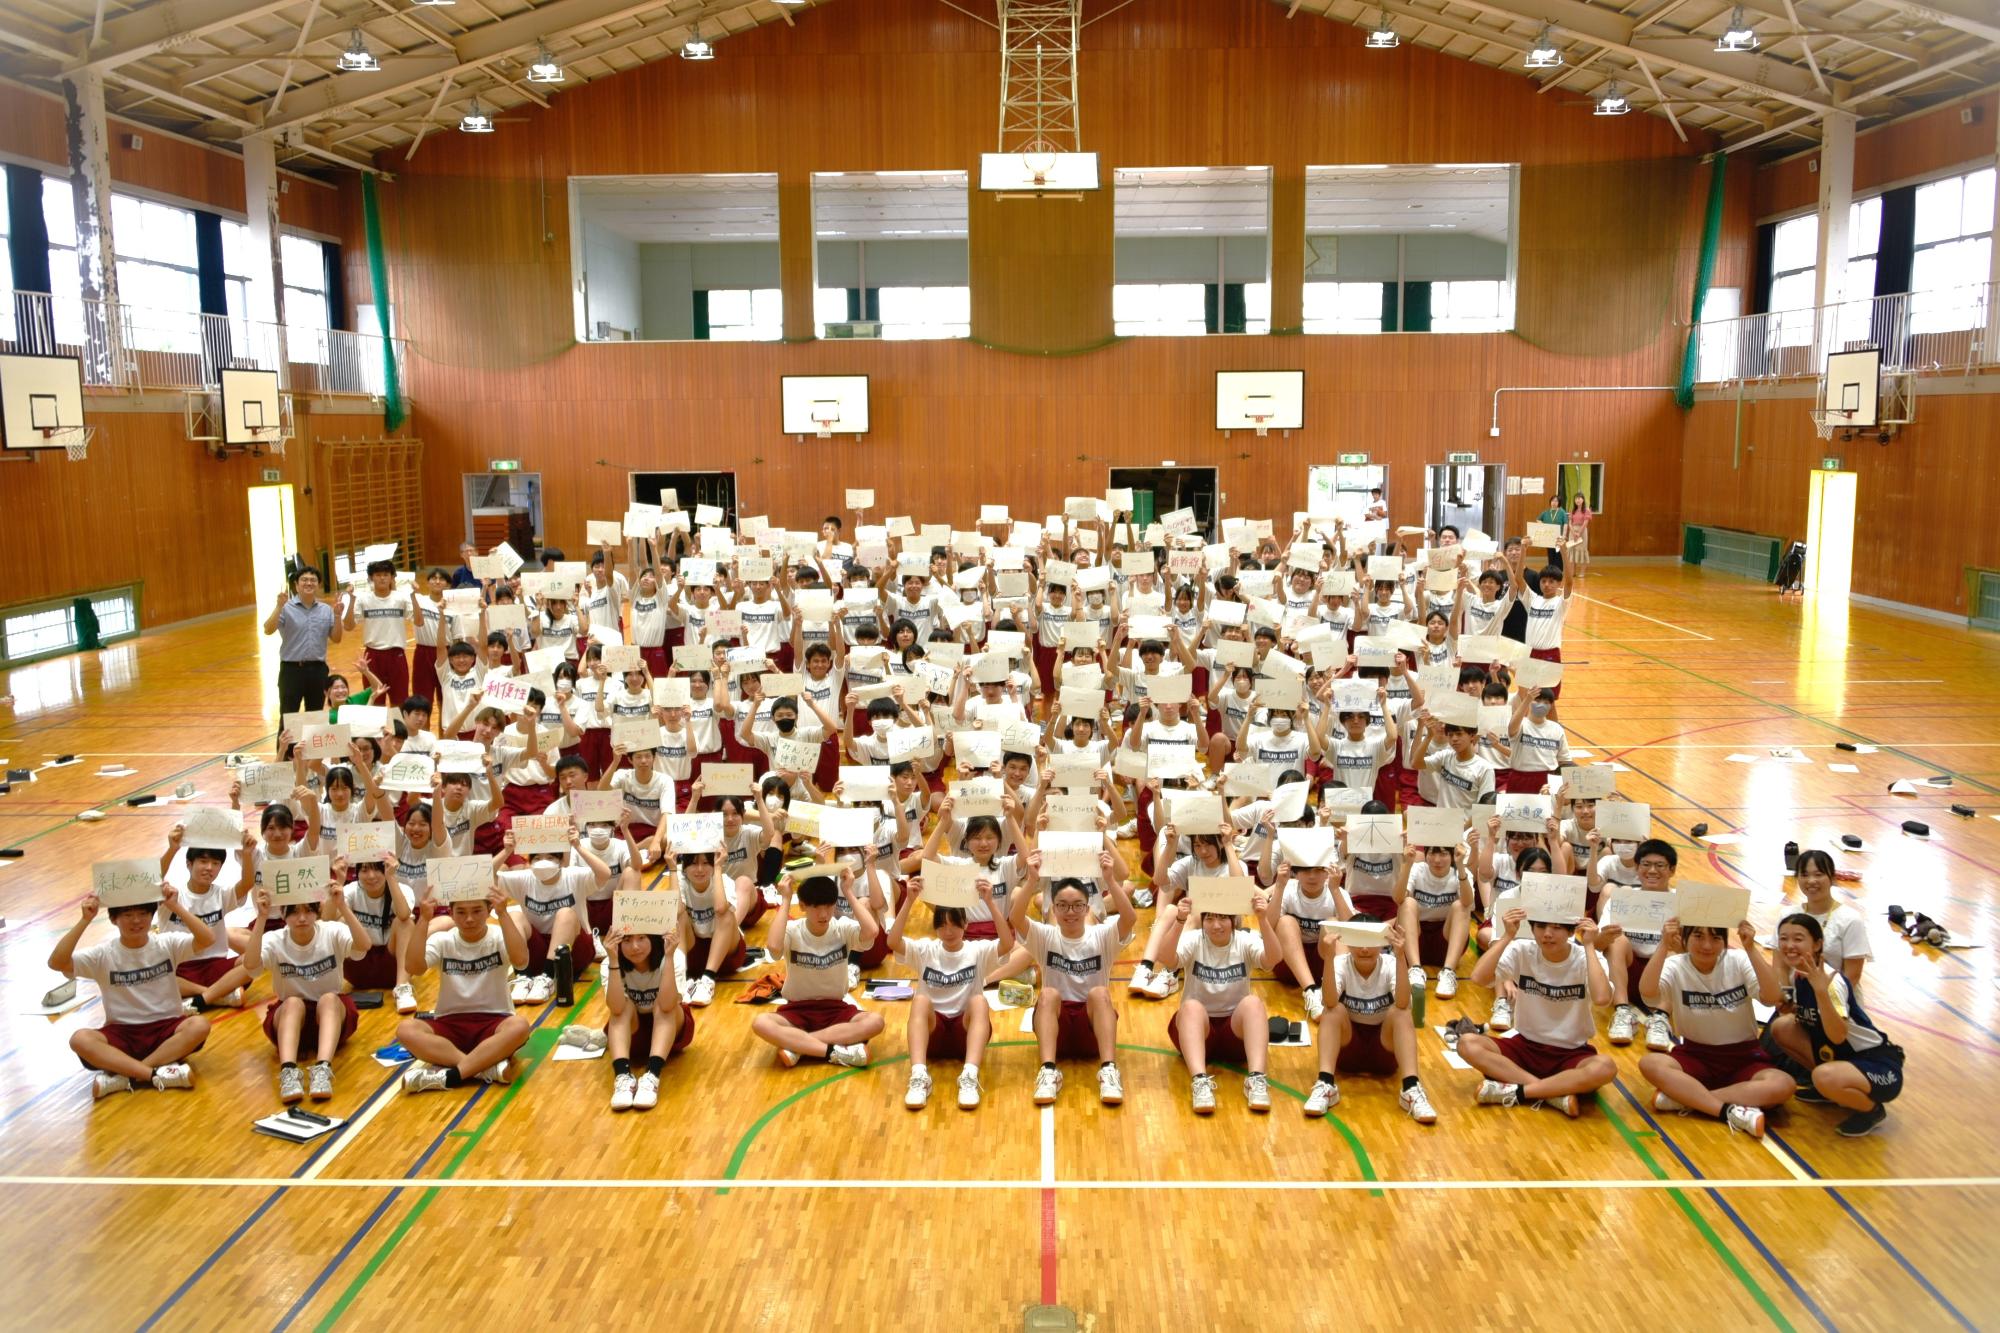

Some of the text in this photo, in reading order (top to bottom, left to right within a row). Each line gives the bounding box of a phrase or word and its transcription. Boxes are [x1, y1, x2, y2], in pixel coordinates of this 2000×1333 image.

[486, 681, 527, 701] 利便性
[312, 732, 337, 748] 自然
[391, 763, 427, 780] 自然
[515, 816, 569, 833] 早稲田駅
[348, 833, 386, 852] 自然
[275, 865, 319, 894] 自然
[526, 897, 570, 911] HONJO MINAMI
[444, 956, 499, 971] HONJO MINAMI
[796, 950, 843, 965] HONJO MINAMI
[1052, 956, 1096, 971] HONJO MINAMI
[138, 964, 169, 980] MINAMI
[304, 958, 332, 975] MINAMI
[1219, 965, 1243, 979] MINAMI
[927, 968, 976, 984] HONJO MINAMI
[1525, 980, 1581, 998] HONJO MINAMI
[1688, 994, 1715, 1006] HONJO
